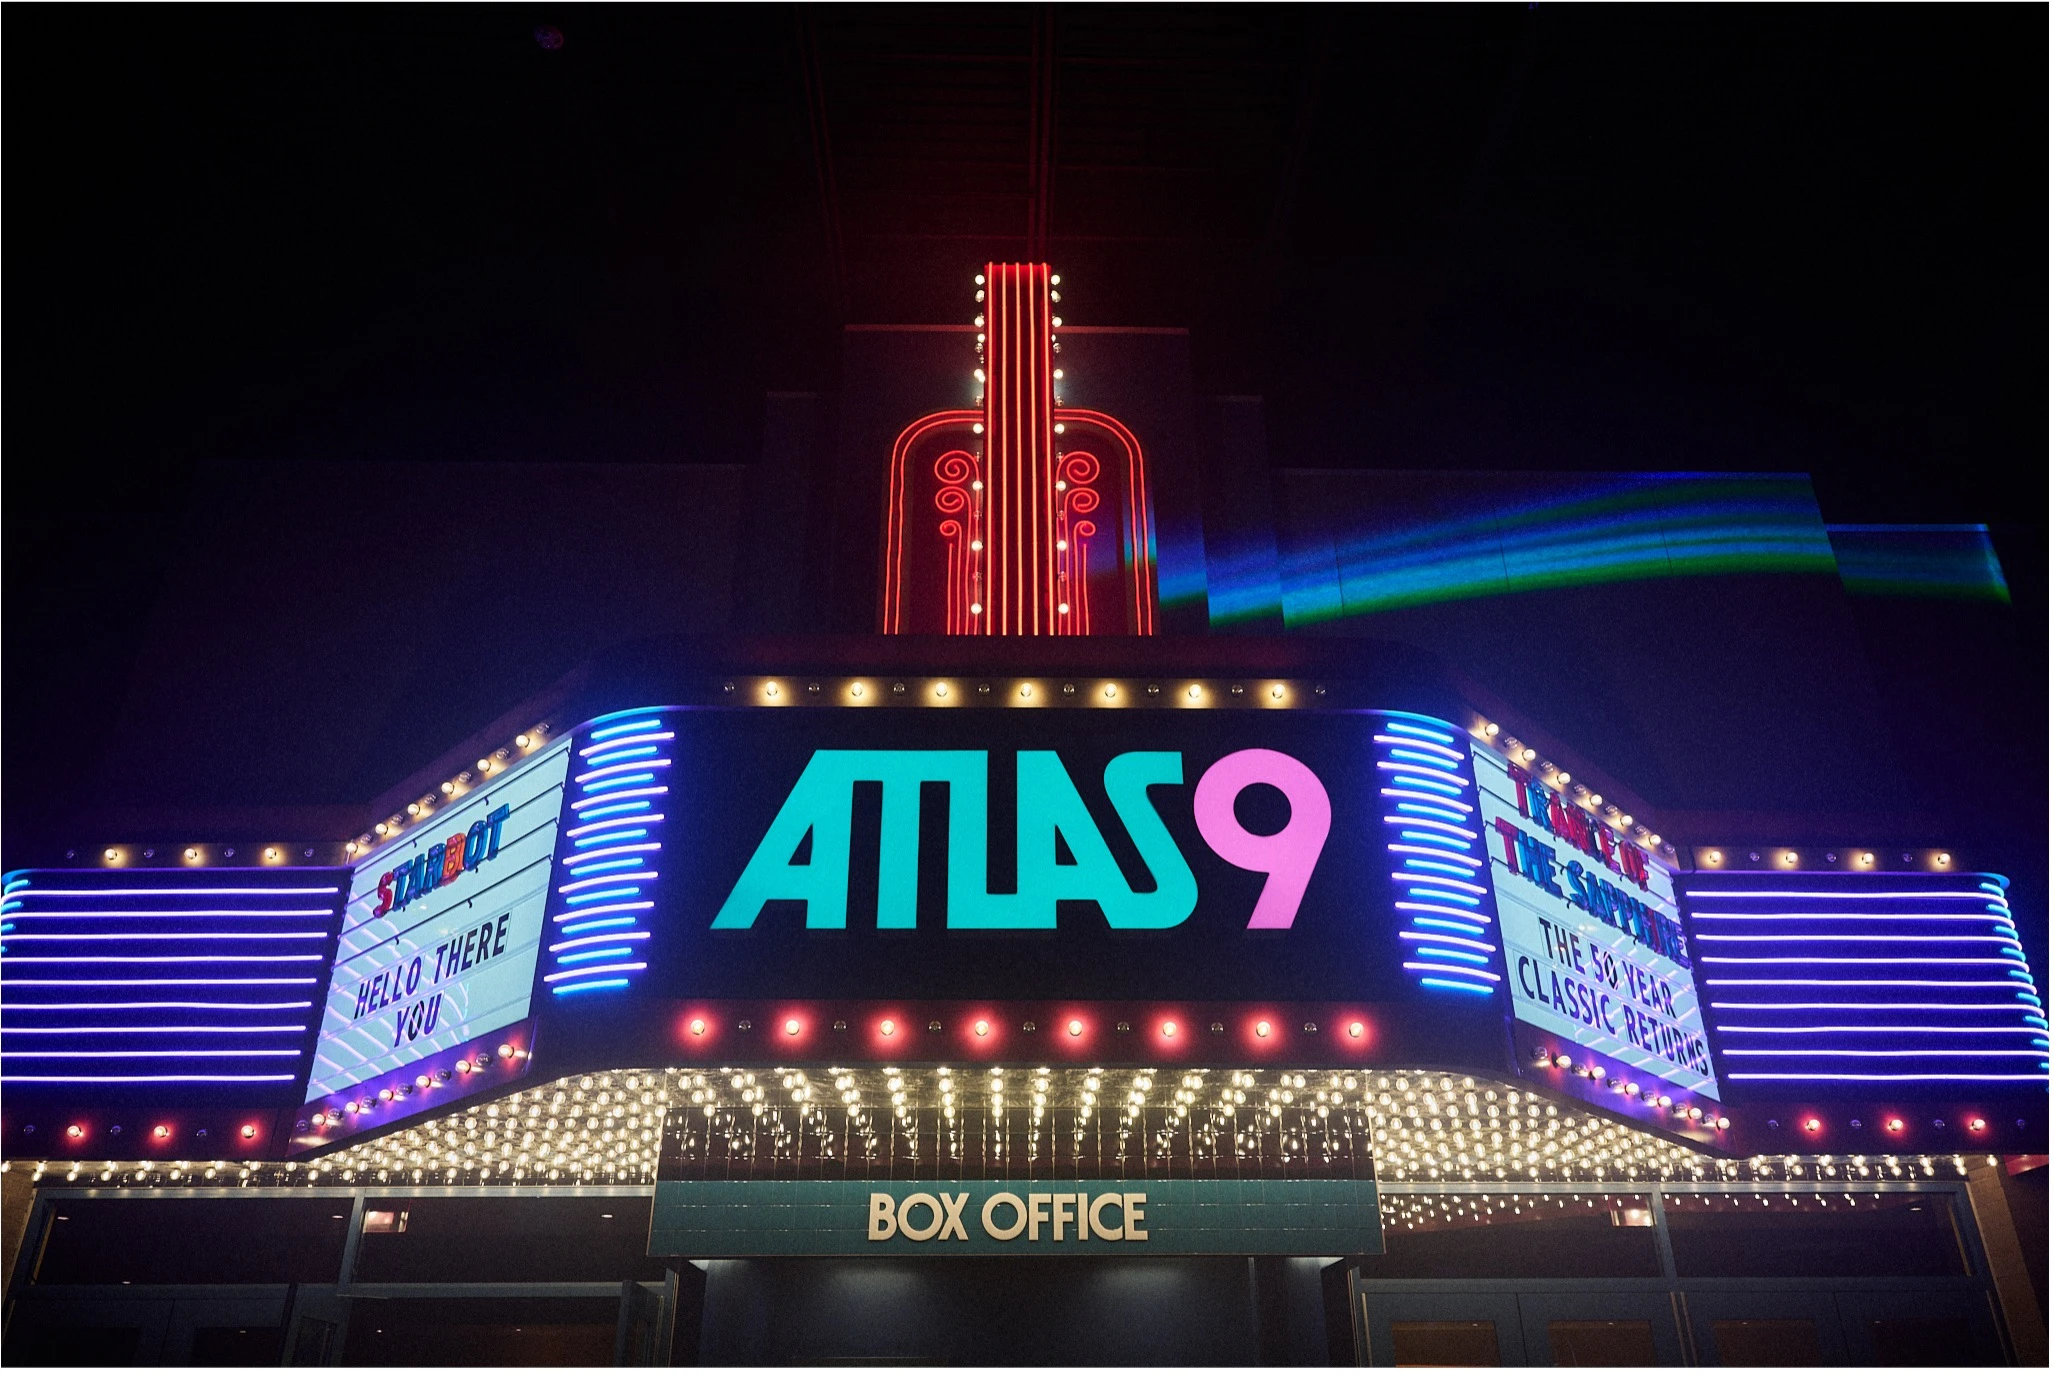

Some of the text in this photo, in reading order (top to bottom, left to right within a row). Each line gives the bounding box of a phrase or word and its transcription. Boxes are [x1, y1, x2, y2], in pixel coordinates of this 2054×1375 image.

[373, 803, 510, 919] STARBOT
[1507, 761, 1649, 892] TRANCE OF
[1495, 816, 1693, 970] THE SAPPHIRE
[353, 912, 510, 1020] HELLO THERE
[393, 993, 443, 1048] YOU
[1518, 955, 1709, 1076] CLASSIC RETURNS
[1538, 916, 1677, 1019] THE 50 YEAR
[868, 1192, 1149, 1242] BOX OFFICE
